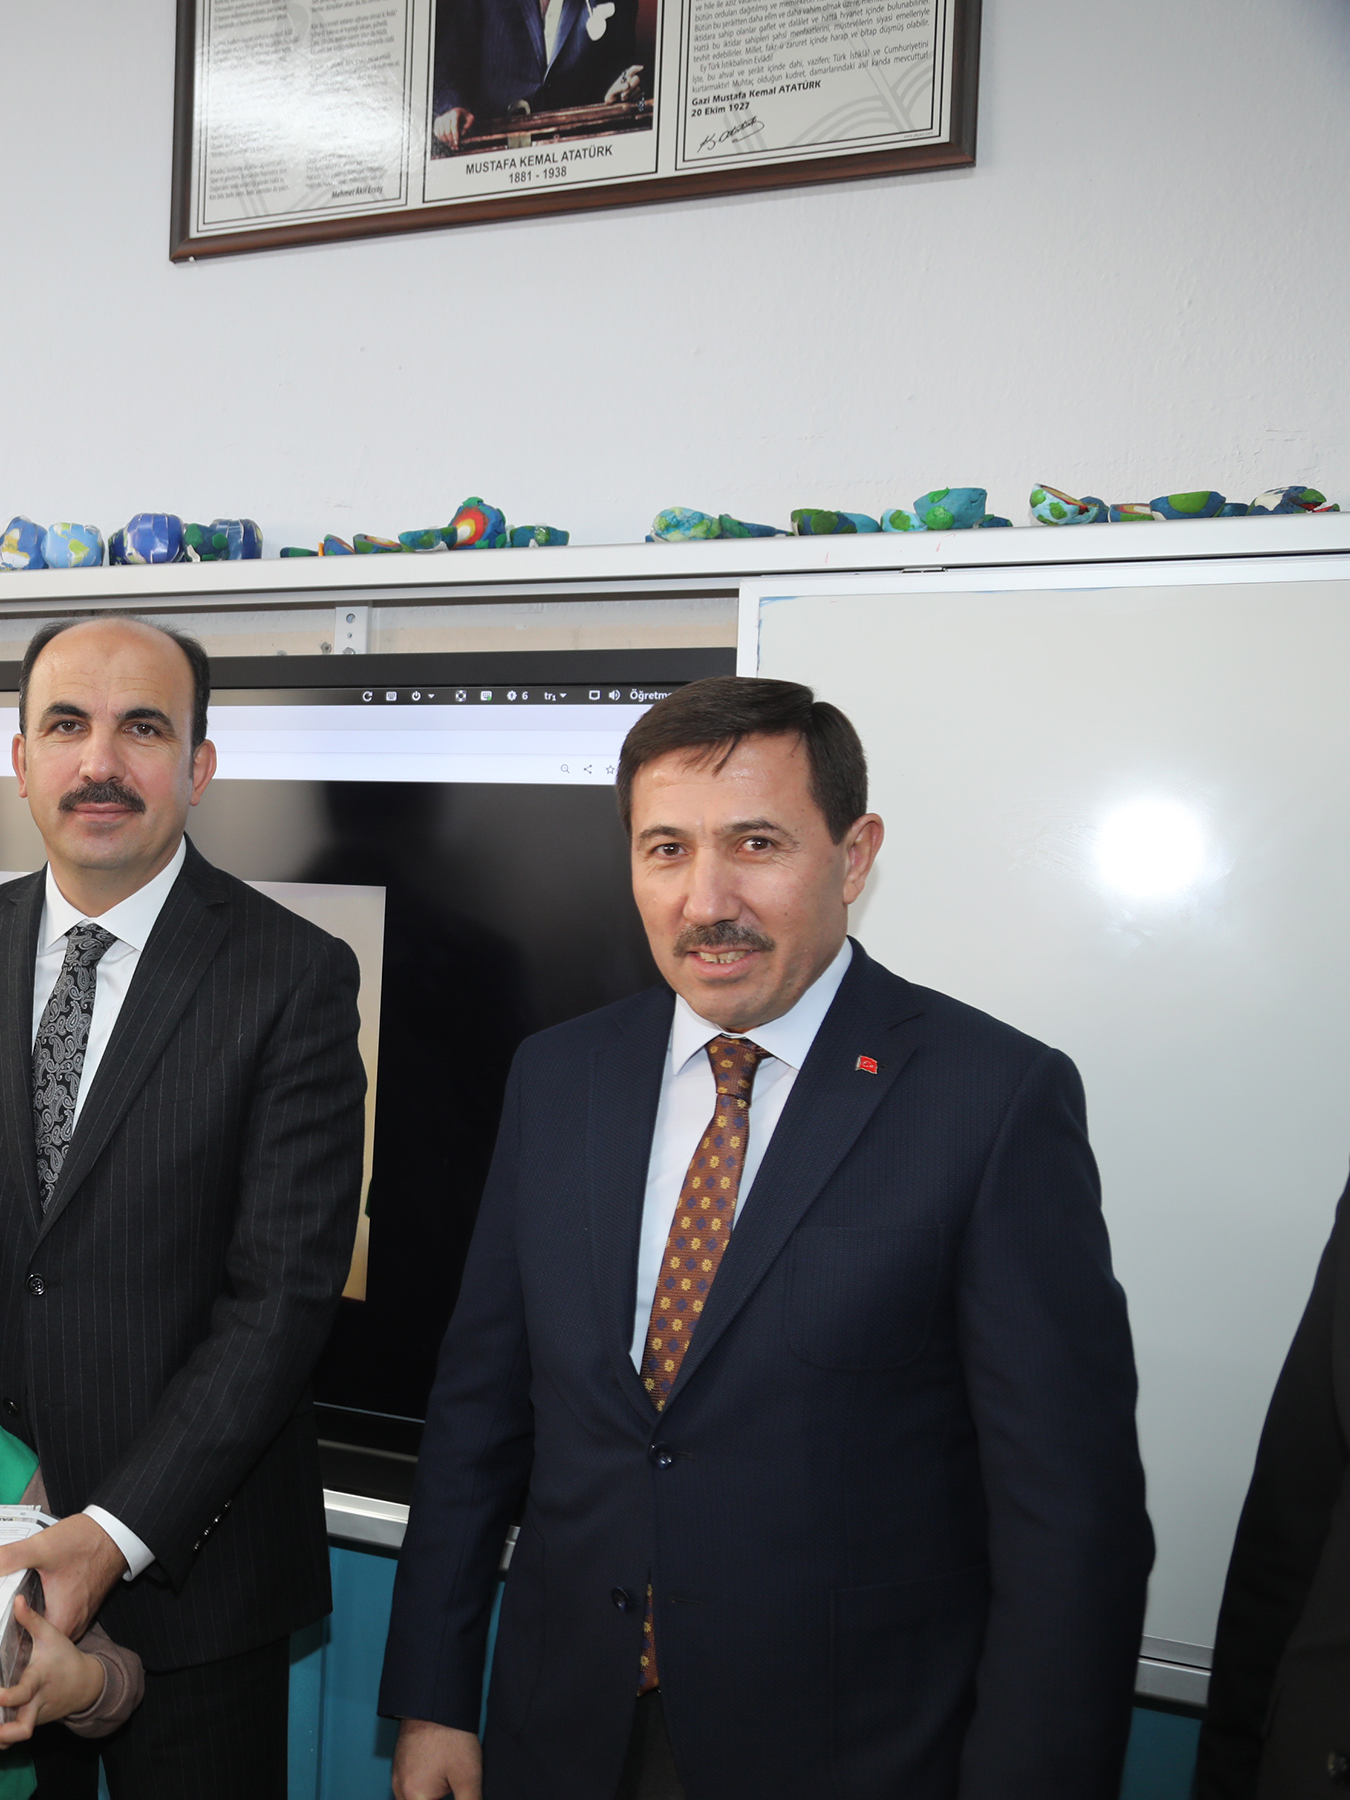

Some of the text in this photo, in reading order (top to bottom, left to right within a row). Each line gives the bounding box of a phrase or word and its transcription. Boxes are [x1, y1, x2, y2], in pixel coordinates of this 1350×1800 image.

[691, 79, 822, 106] Gazi Mustafa Kemal ATATÜRK
[691, 102, 750, 117] 20 Ekim 1927
[465, 144, 613, 175] MUSTAFA KEMAL ATATÜRK
[508, 171, 533, 184] 1881
[542, 166, 568, 180] 1938
[521, 691, 529, 701] 6
